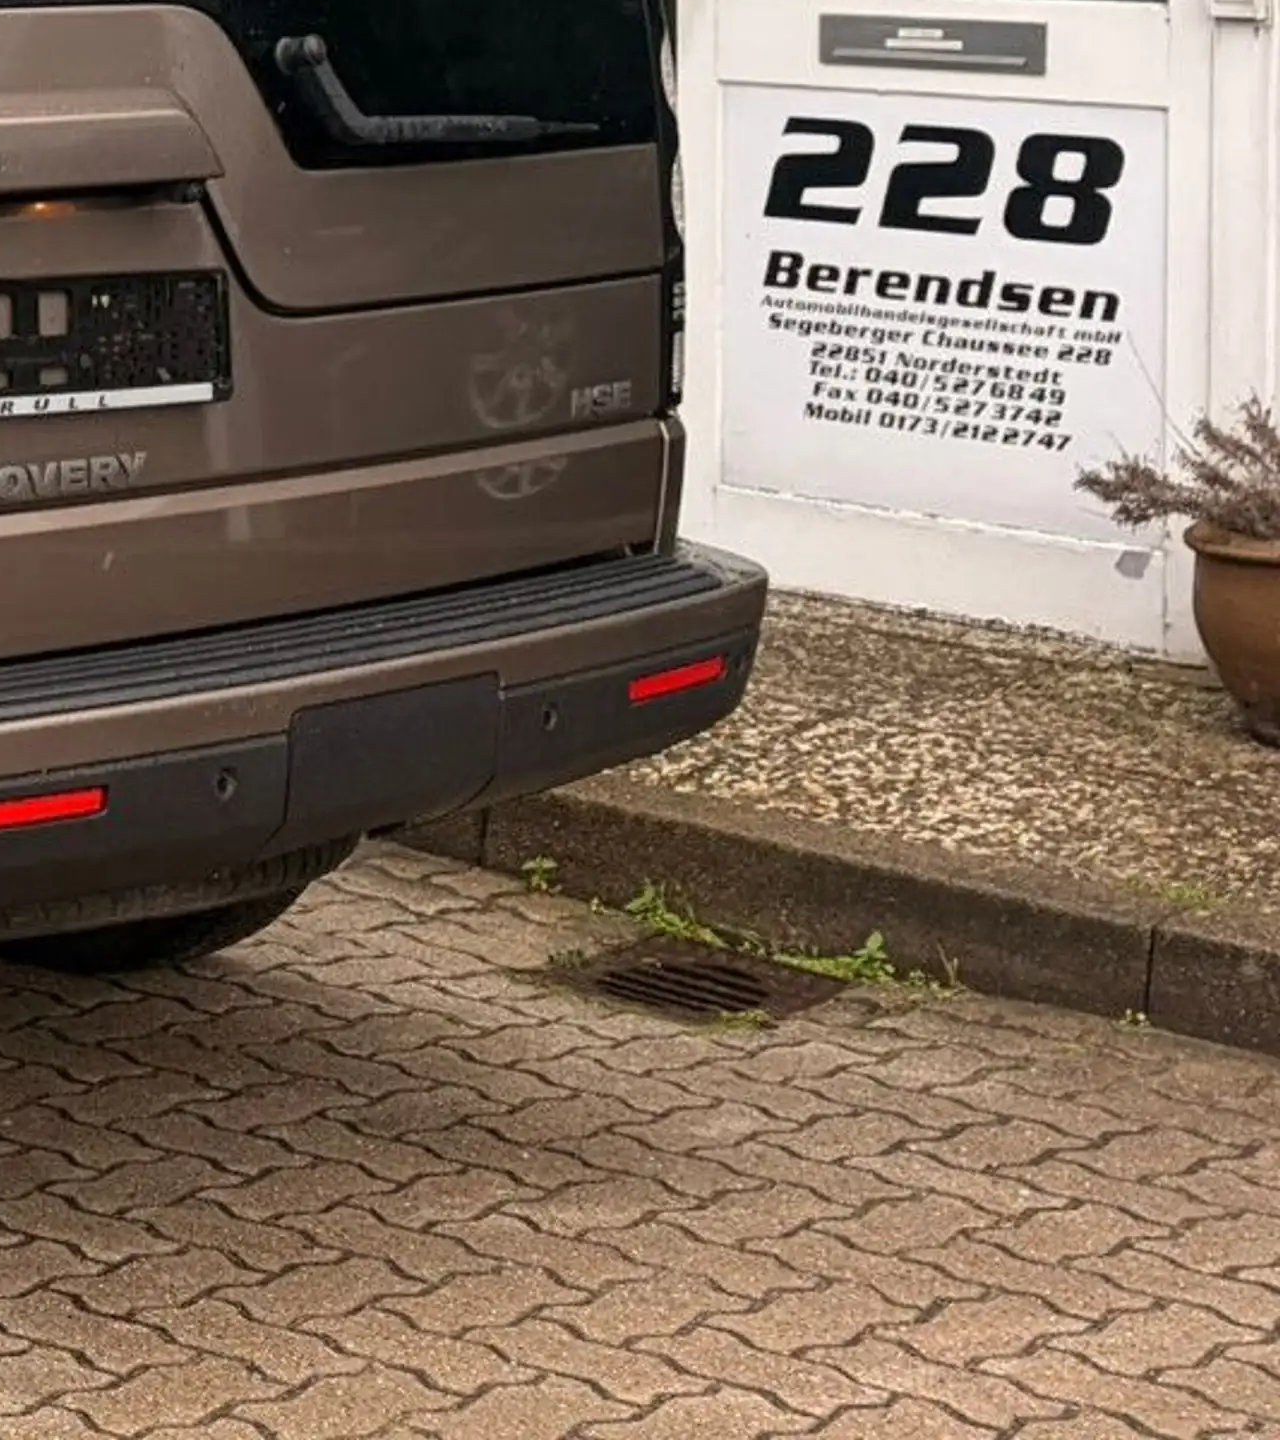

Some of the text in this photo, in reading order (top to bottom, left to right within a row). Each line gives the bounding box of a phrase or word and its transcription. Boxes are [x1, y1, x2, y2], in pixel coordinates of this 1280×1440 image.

[763, 115, 1126, 246] 228
[762, 249, 1121, 323] Berendsen
[760, 294, 1122, 345] Automobilhandelsgesellschaft mbH
[768, 311, 1113, 366] Segeberger Chaussee 228
[811, 341, 1064, 387] 22851 Norderstedt
[570, 378, 633, 420] HSE
[803, 401, 873, 426] Mobil
[812, 380, 858, 402] Fax
